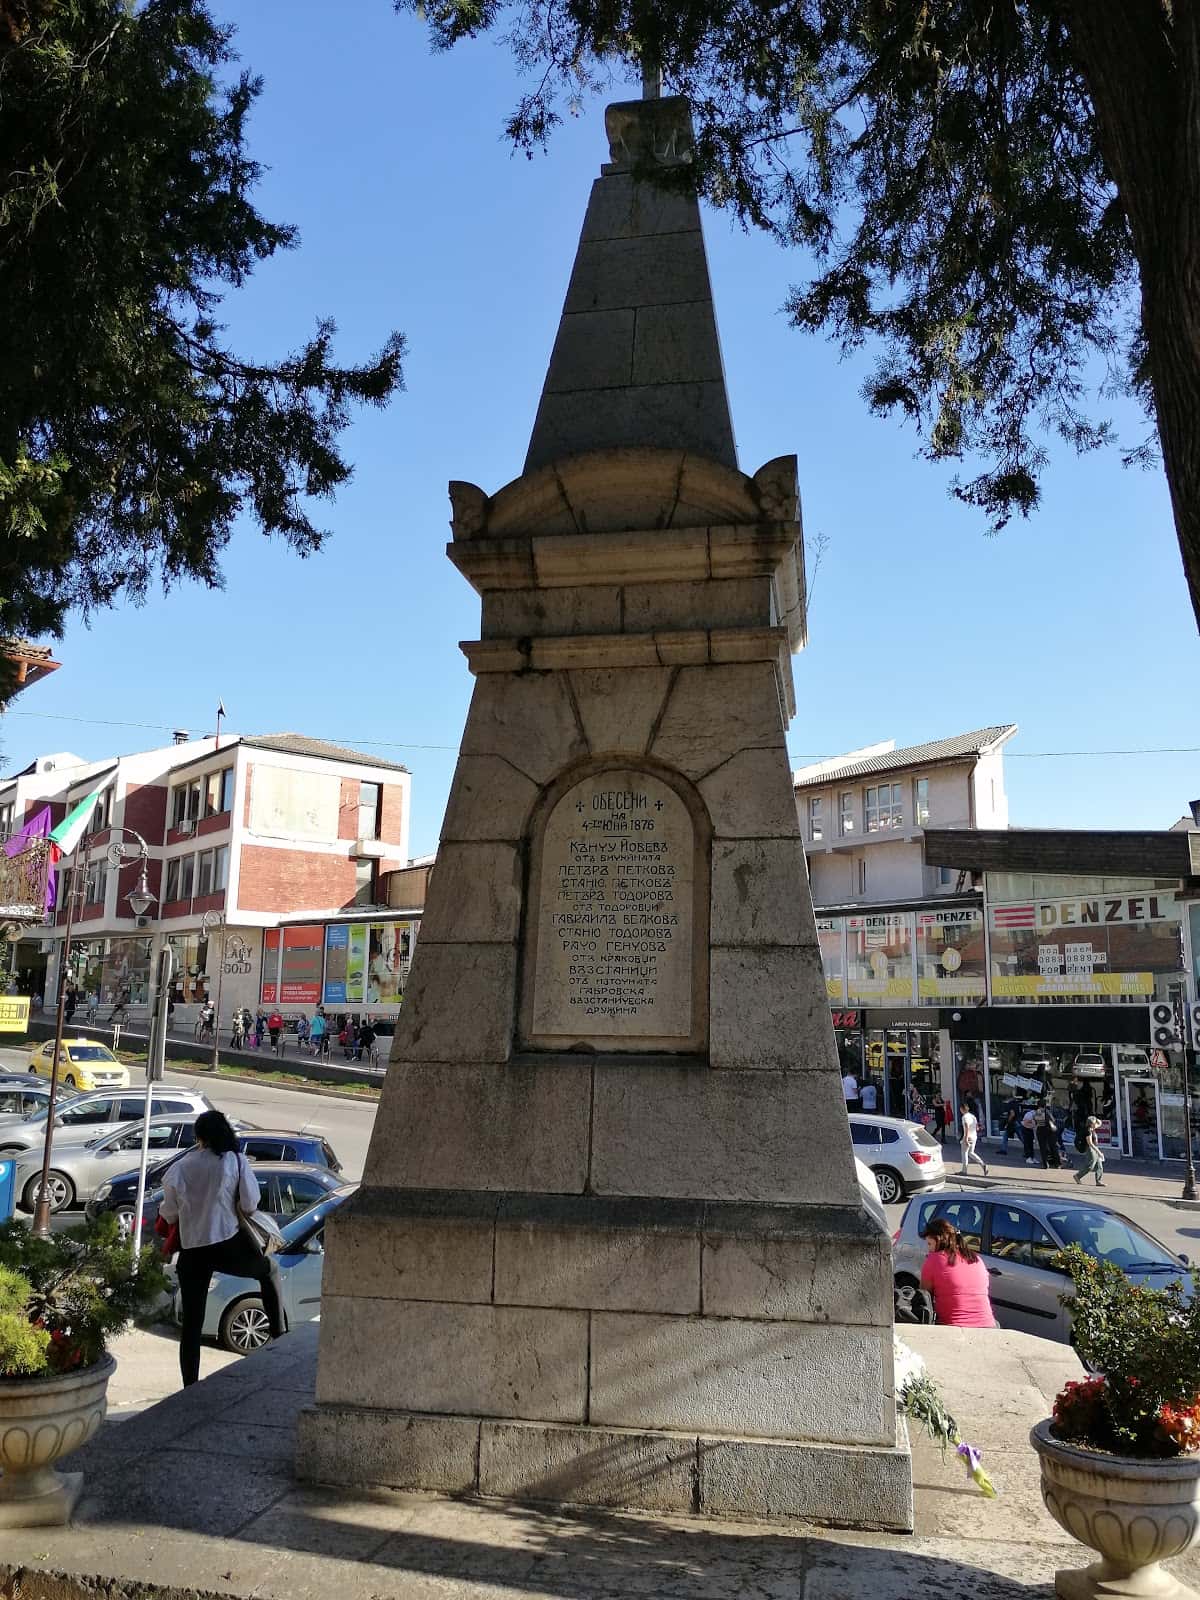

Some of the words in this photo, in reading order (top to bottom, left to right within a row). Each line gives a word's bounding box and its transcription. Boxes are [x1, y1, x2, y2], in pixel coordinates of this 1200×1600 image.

[592, 791, 647, 810] ОБЕСЕНИ
[611, 812, 626, 820] НА
[630, 819, 655, 831] 1876
[559, 865, 609, 875] ПЕТЪРЪ
[617, 865, 675, 875] ПЕТКОВЪ
[558, 891, 605, 901] ПЕТЪРЪ
[613, 890, 673, 902] ТОДОРОВЪ
[936, 911, 979, 922] DENZEL
[1040, 896, 1168, 926] DENZEL
[608, 928, 672, 939] ТОДОРОВЪ
[606, 941, 666, 952] ГЕНЧОВЪ
[223, 963, 252, 975] GOLD
[569, 966, 657, 977] ВЪЗСТАНИЦИ
[580, 987, 645, 996] ГАБРОВСКА
